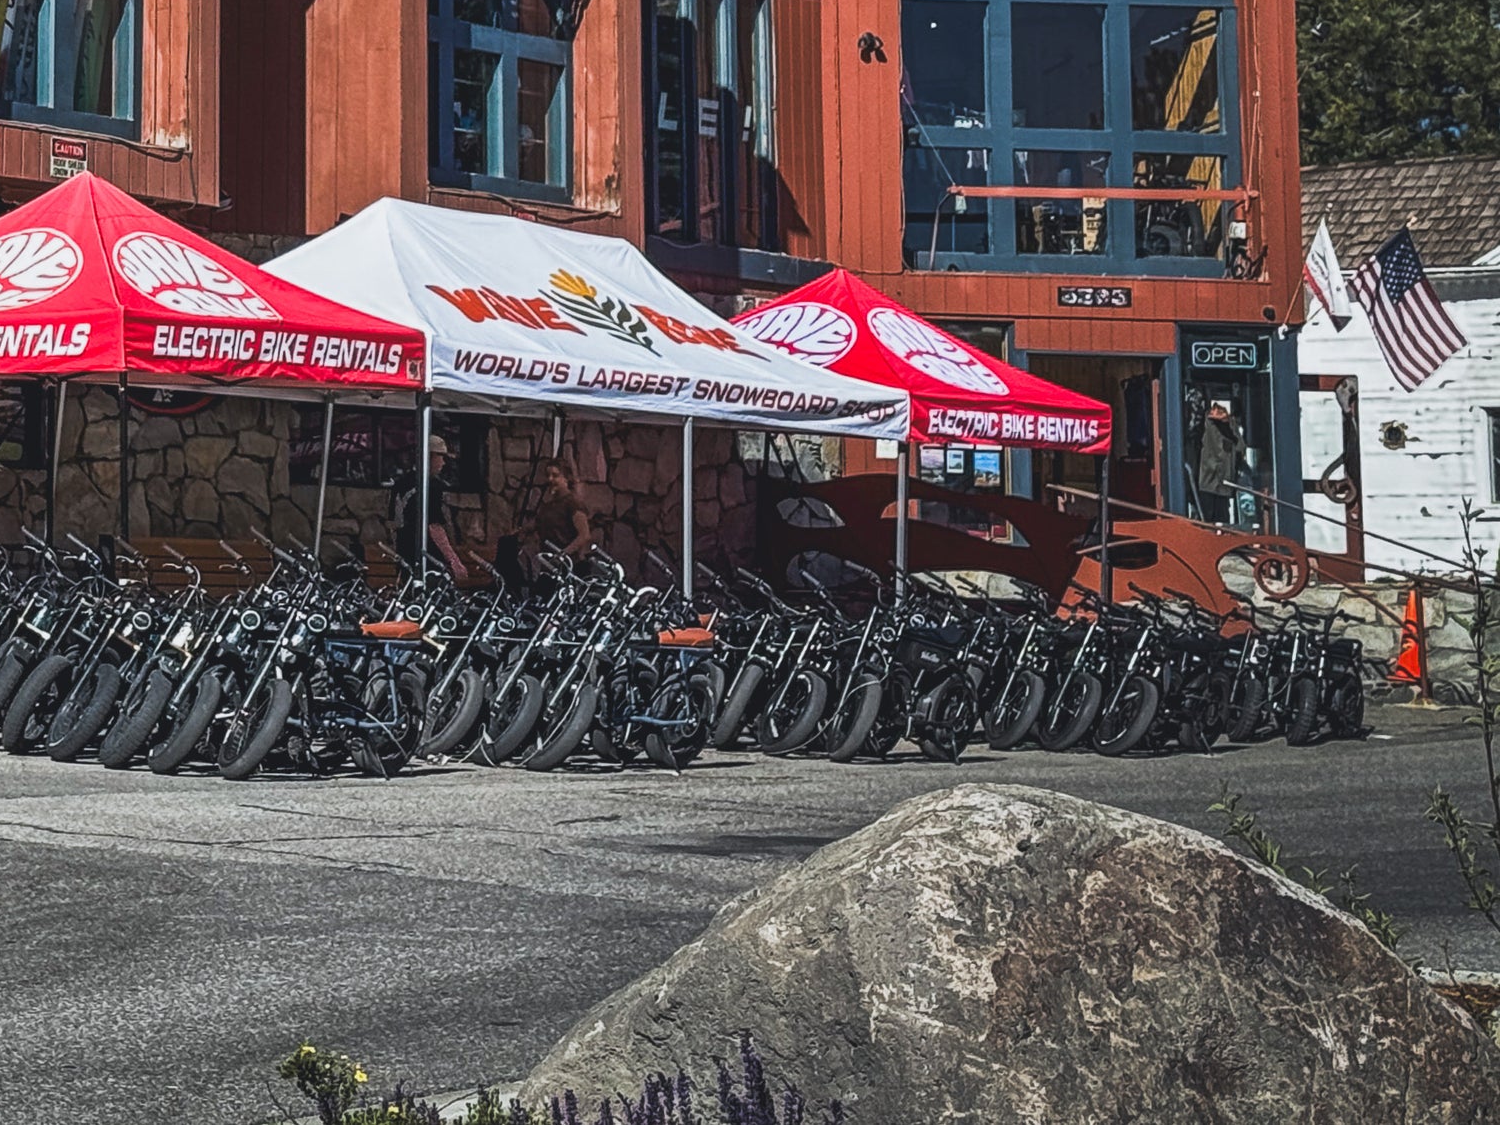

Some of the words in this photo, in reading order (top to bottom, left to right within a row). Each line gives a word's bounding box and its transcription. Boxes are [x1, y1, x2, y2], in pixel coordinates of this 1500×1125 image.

[118, 235, 246, 295] WAVE
[425, 284, 588, 337] WAVE
[153, 325, 255, 361] ELECTRIC
[258, 331, 309, 364] BIKE
[311, 336, 402, 374] RENTALS
[1194, 346, 1254, 364] OPEN
[453, 348, 571, 384] WORLD'S
[576, 367, 690, 398] LARGEST
[692, 378, 838, 415] SNOWBOARD
[837, 399, 896, 422] SHOP
[928, 409, 999, 437] ELECTRIC
[1001, 413, 1035, 439] BIKE
[1037, 416, 1099, 443] RENTALS
